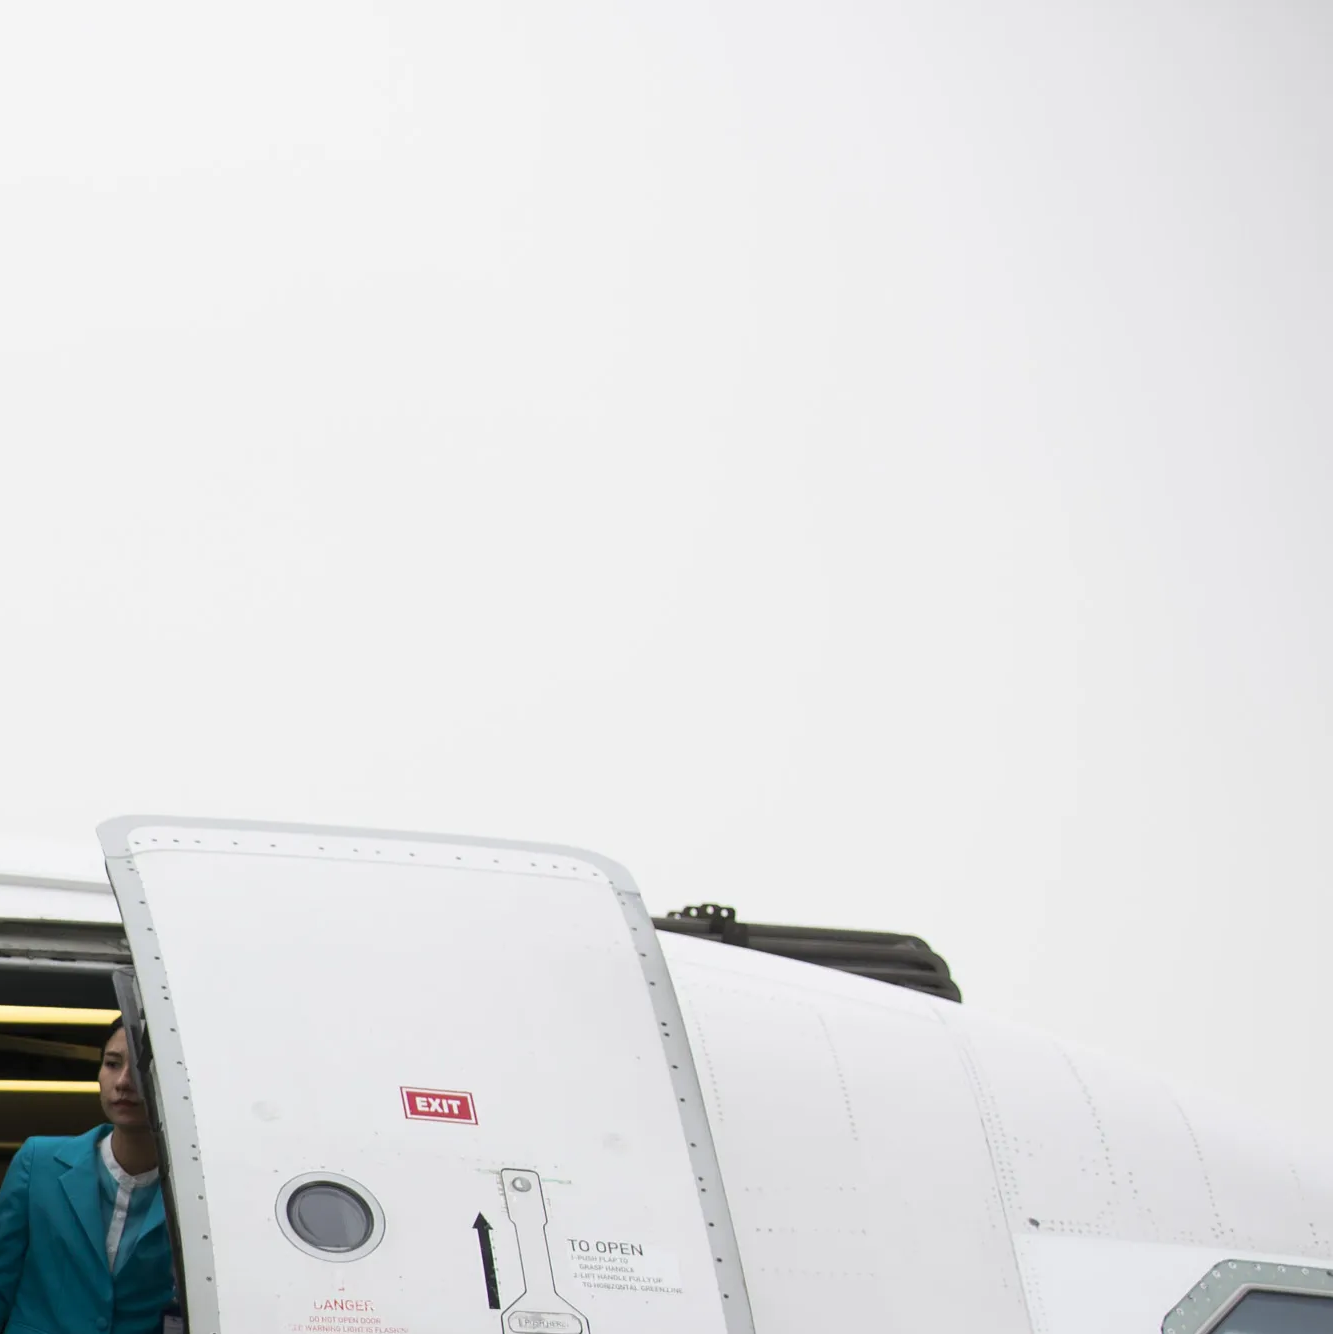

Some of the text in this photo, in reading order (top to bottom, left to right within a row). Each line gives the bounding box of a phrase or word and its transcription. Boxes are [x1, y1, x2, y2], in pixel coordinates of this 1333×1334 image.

[415, 1096, 461, 1115] EXIT
[567, 1238, 644, 1256] TO OPEN
